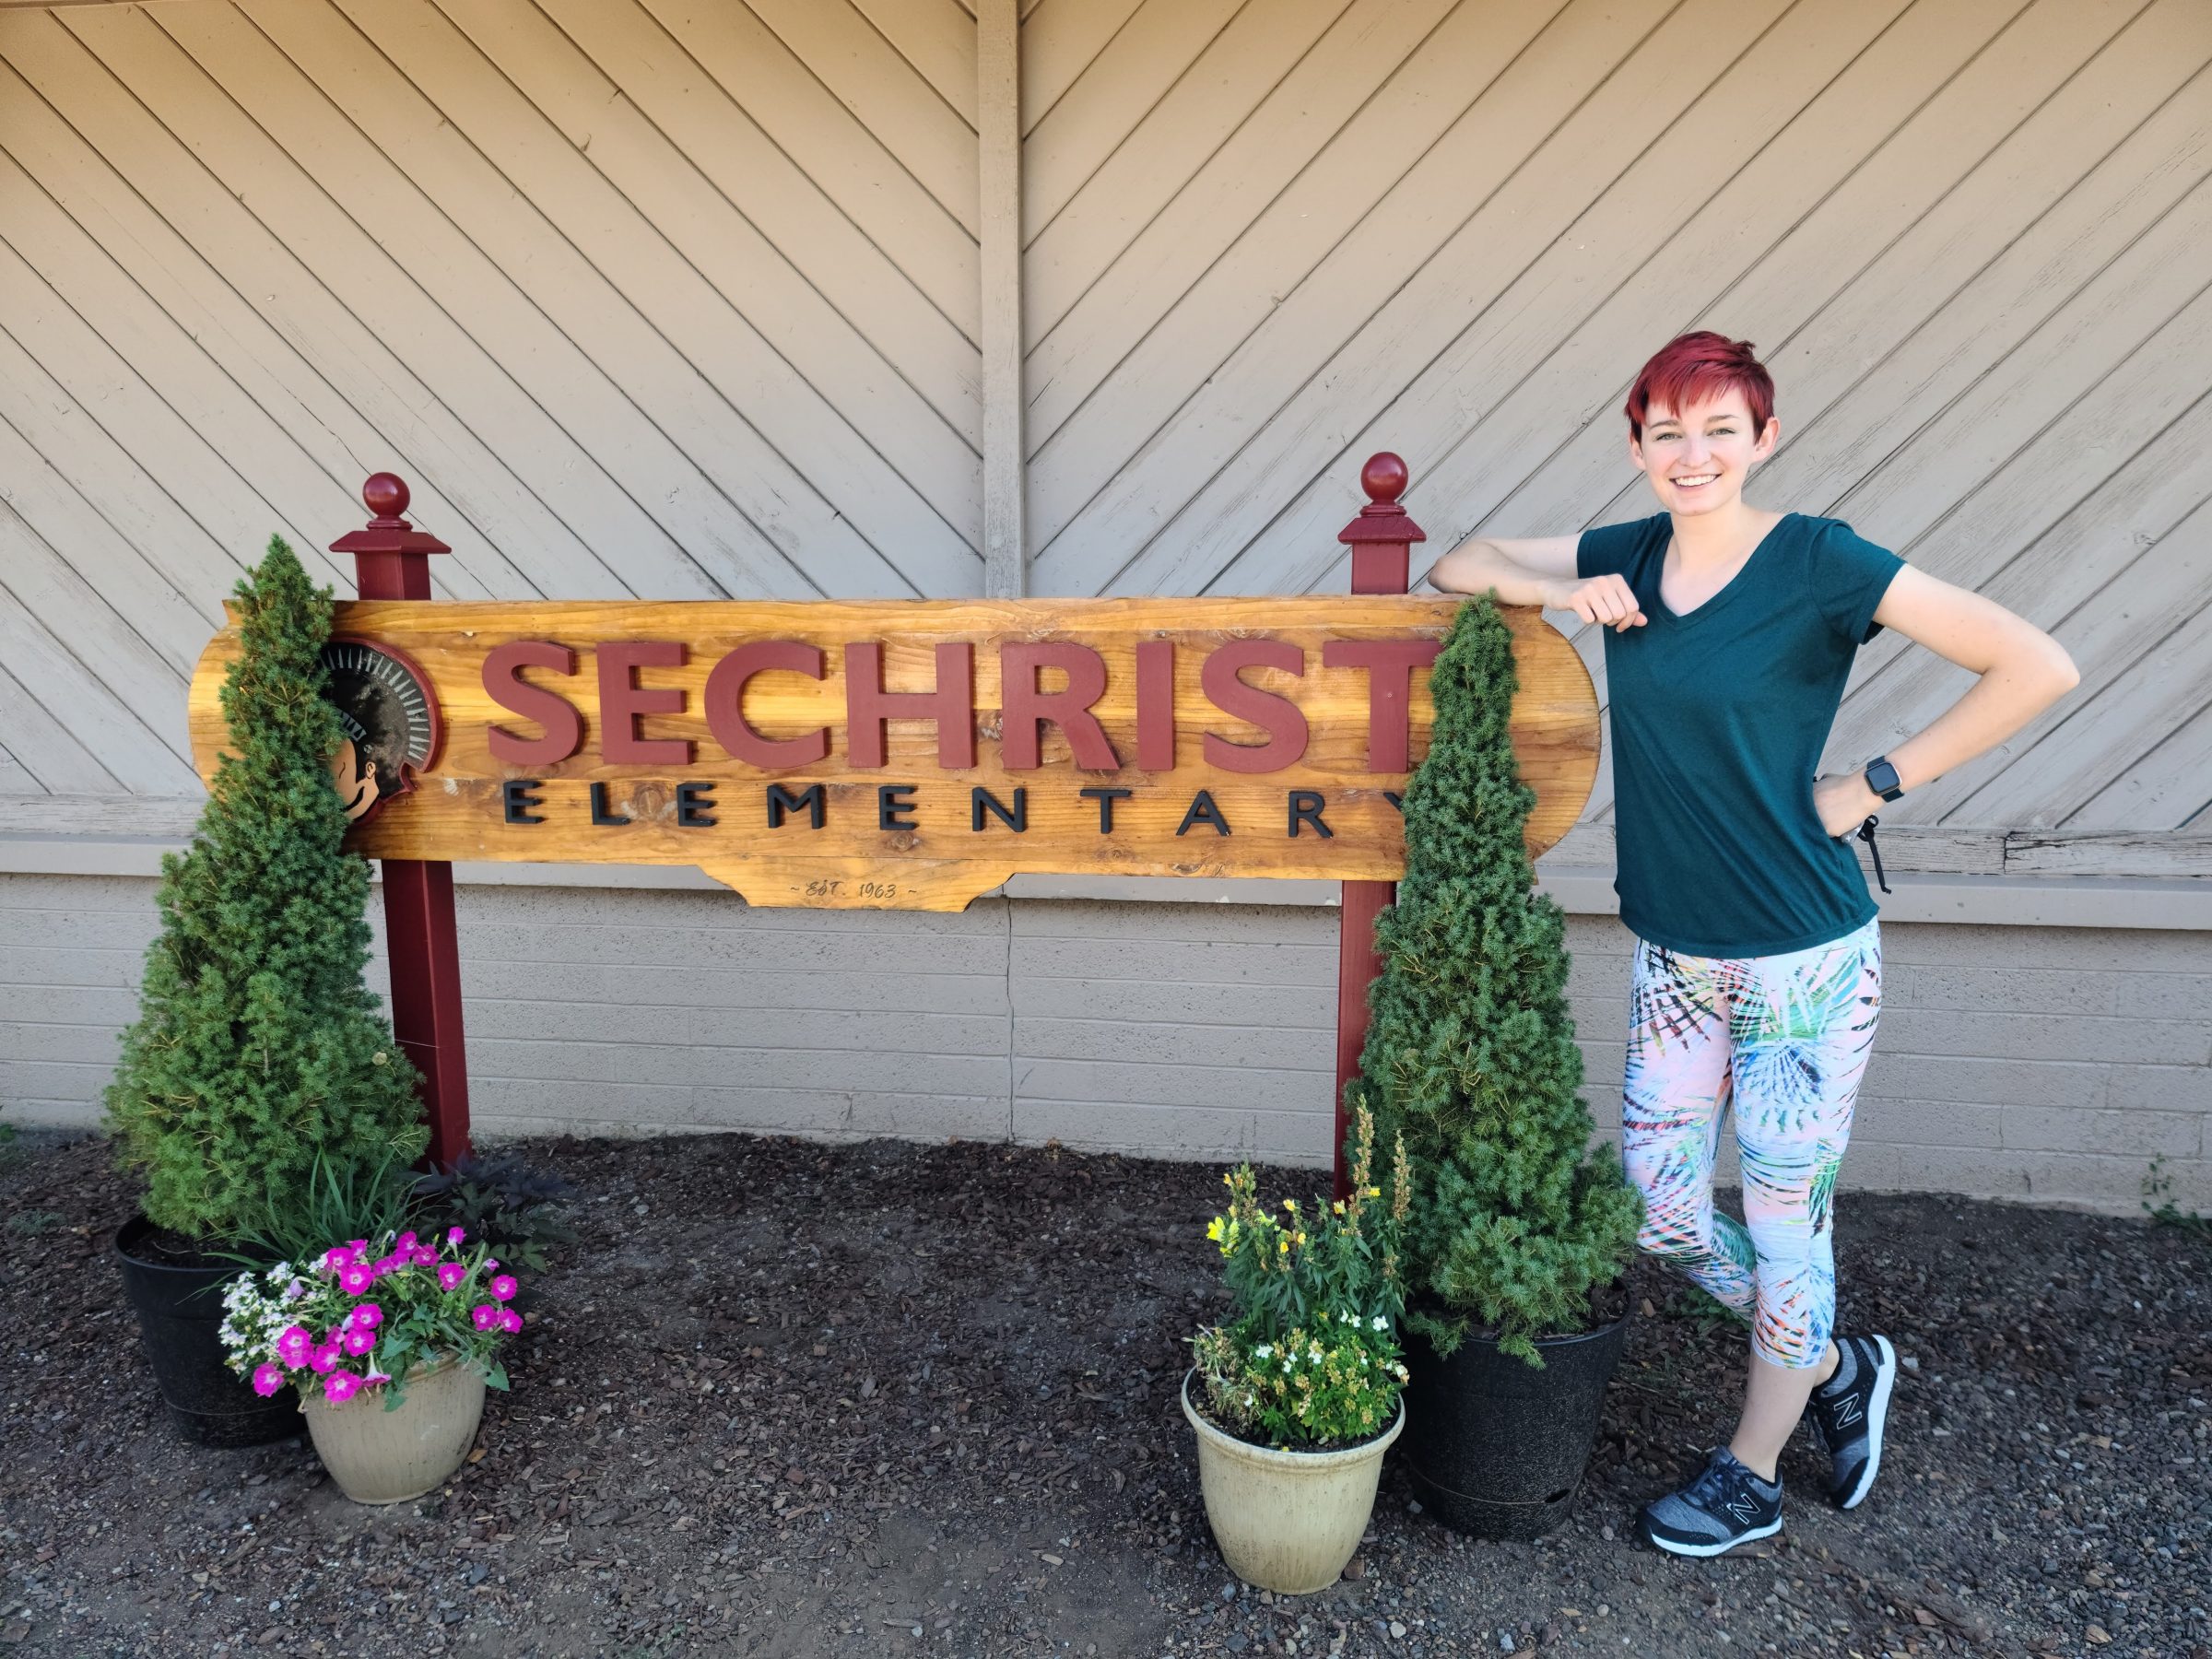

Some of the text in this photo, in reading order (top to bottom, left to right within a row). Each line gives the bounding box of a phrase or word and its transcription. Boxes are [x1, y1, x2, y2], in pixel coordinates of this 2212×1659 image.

[481, 640, 1447, 774] SECHRIST
[503, 780, 1403, 839] ELEMENTAR
[859, 882, 897, 899] 1963
[1833, 1392, 1863, 1430] N
[1726, 1492, 1761, 1525] N
